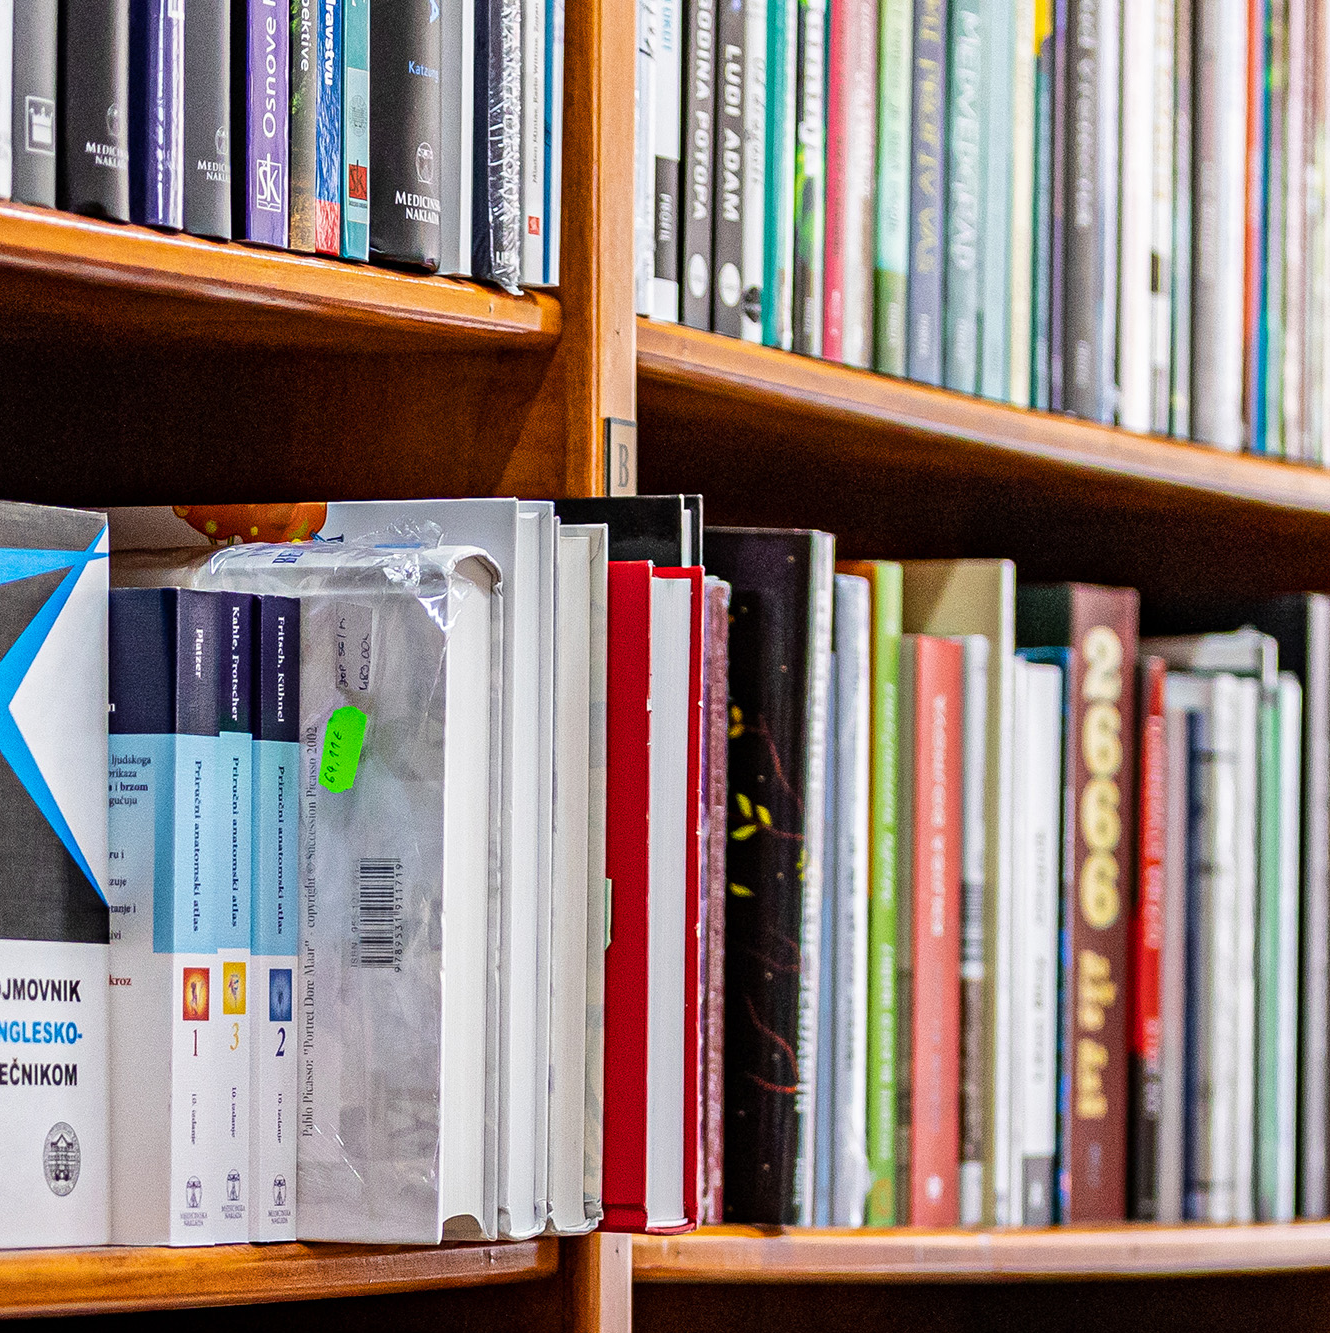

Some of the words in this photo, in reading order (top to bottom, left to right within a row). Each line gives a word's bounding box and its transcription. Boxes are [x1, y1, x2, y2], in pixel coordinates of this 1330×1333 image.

[262, 16, 277, 138] Osnove
[408, 60, 439, 83] Katzung
[724, 44, 742, 117] LUDI
[692, 110, 710, 220] POTOPA
[722, 128, 740, 222] ADAM
[395, 190, 440, 212] MEDICINS
[617, 442, 629, 488] B
[231, 606, 241, 653] Kahle,
[276, 616, 286, 669] Fritsch,
[195, 628, 204, 679] Platzer
[230, 655, 240, 723] Frotscher
[276, 672, 285, 724] Kühnel
[111, 752, 152, 766] ljudskoga
[306, 726, 318, 755] 2002
[121, 783, 149, 796] brzom
[193, 760, 203, 819] Priručni
[231, 756, 241, 816] Priručni
[277, 765, 286, 824] Priručni
[306, 759, 318, 798] Picasso
[1080, 627, 1124, 929] 2666
[306, 801, 318, 860] Succession
[192, 824, 203, 898] anatomski
[231, 820, 240, 894] anatomski
[276, 827, 285, 900] anatomski
[191, 900, 201, 934] atlas
[230, 896, 240, 930] atlas
[276, 903, 284, 935] atlas
[306, 877, 318, 928] copyright
[304, 939, 316, 976] Maar"
[350, 941, 359, 968] ISBN
[109, 974, 132, 986] kroz
[304, 980, 315, 1007] Dore
[193, 1028, 198, 1057] 1
[230, 1022, 240, 1051] 3
[275, 1027, 286, 1057] 2
[303, 1011, 316, 1056] "Portret
[302, 1059, 314, 1105] Picasso:
[302, 1106, 314, 1138] Pablo
